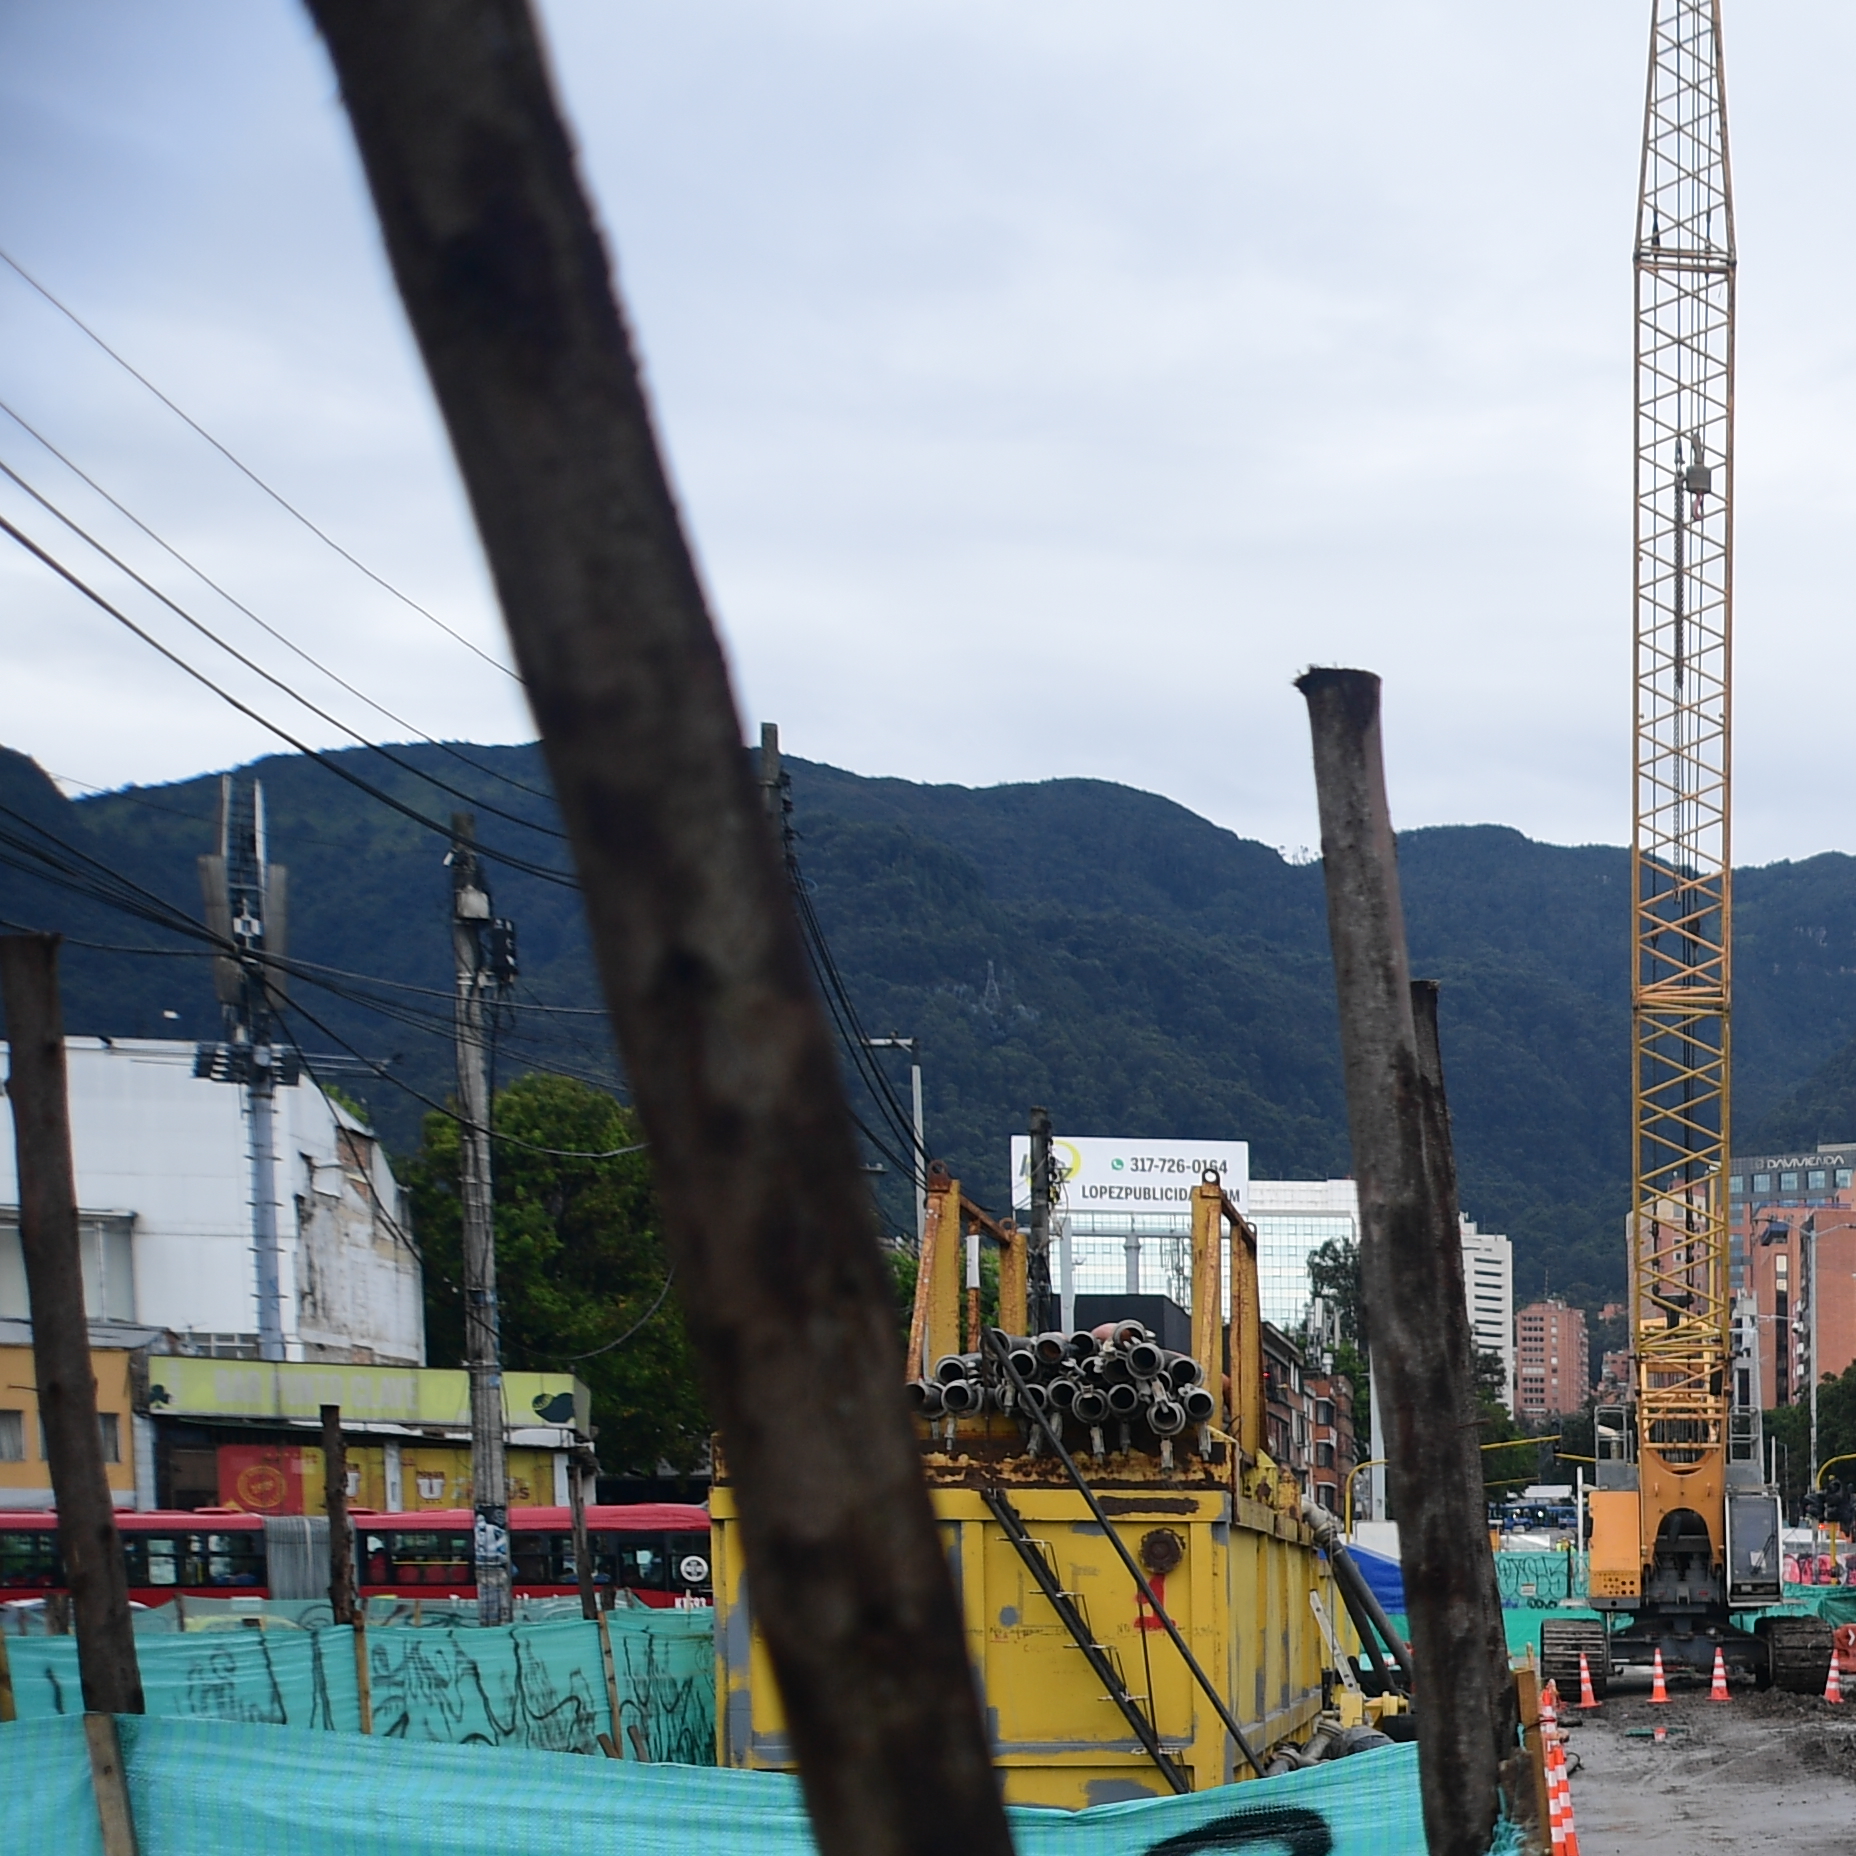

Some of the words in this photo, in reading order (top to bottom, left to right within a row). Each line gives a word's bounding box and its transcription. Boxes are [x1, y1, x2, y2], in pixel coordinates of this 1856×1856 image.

[1130, 1157, 1227, 1174] 317-726-0164
[1767, 1155, 1845, 1169] DAVIVIENDA
[1081, 1184, 1240, 1202] LOPEZPUBLICIDM
